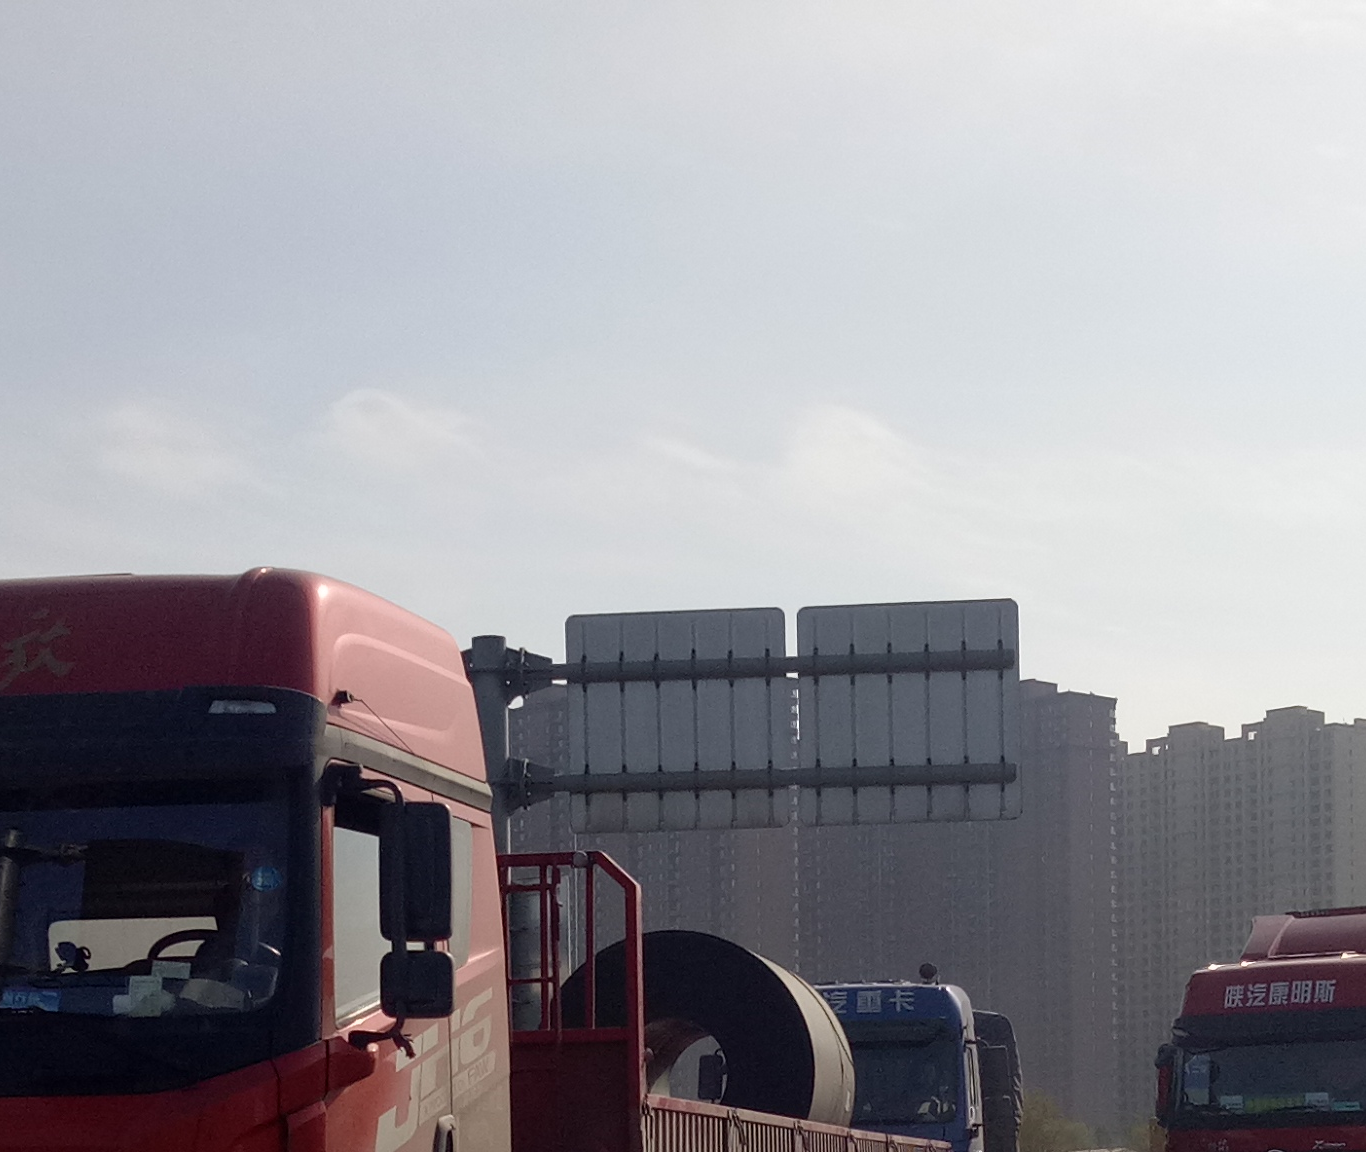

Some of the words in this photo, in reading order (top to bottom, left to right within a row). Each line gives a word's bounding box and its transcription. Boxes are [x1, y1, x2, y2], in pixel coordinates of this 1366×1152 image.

[1224, 979, 1337, 1009] 陕汽康明斯
